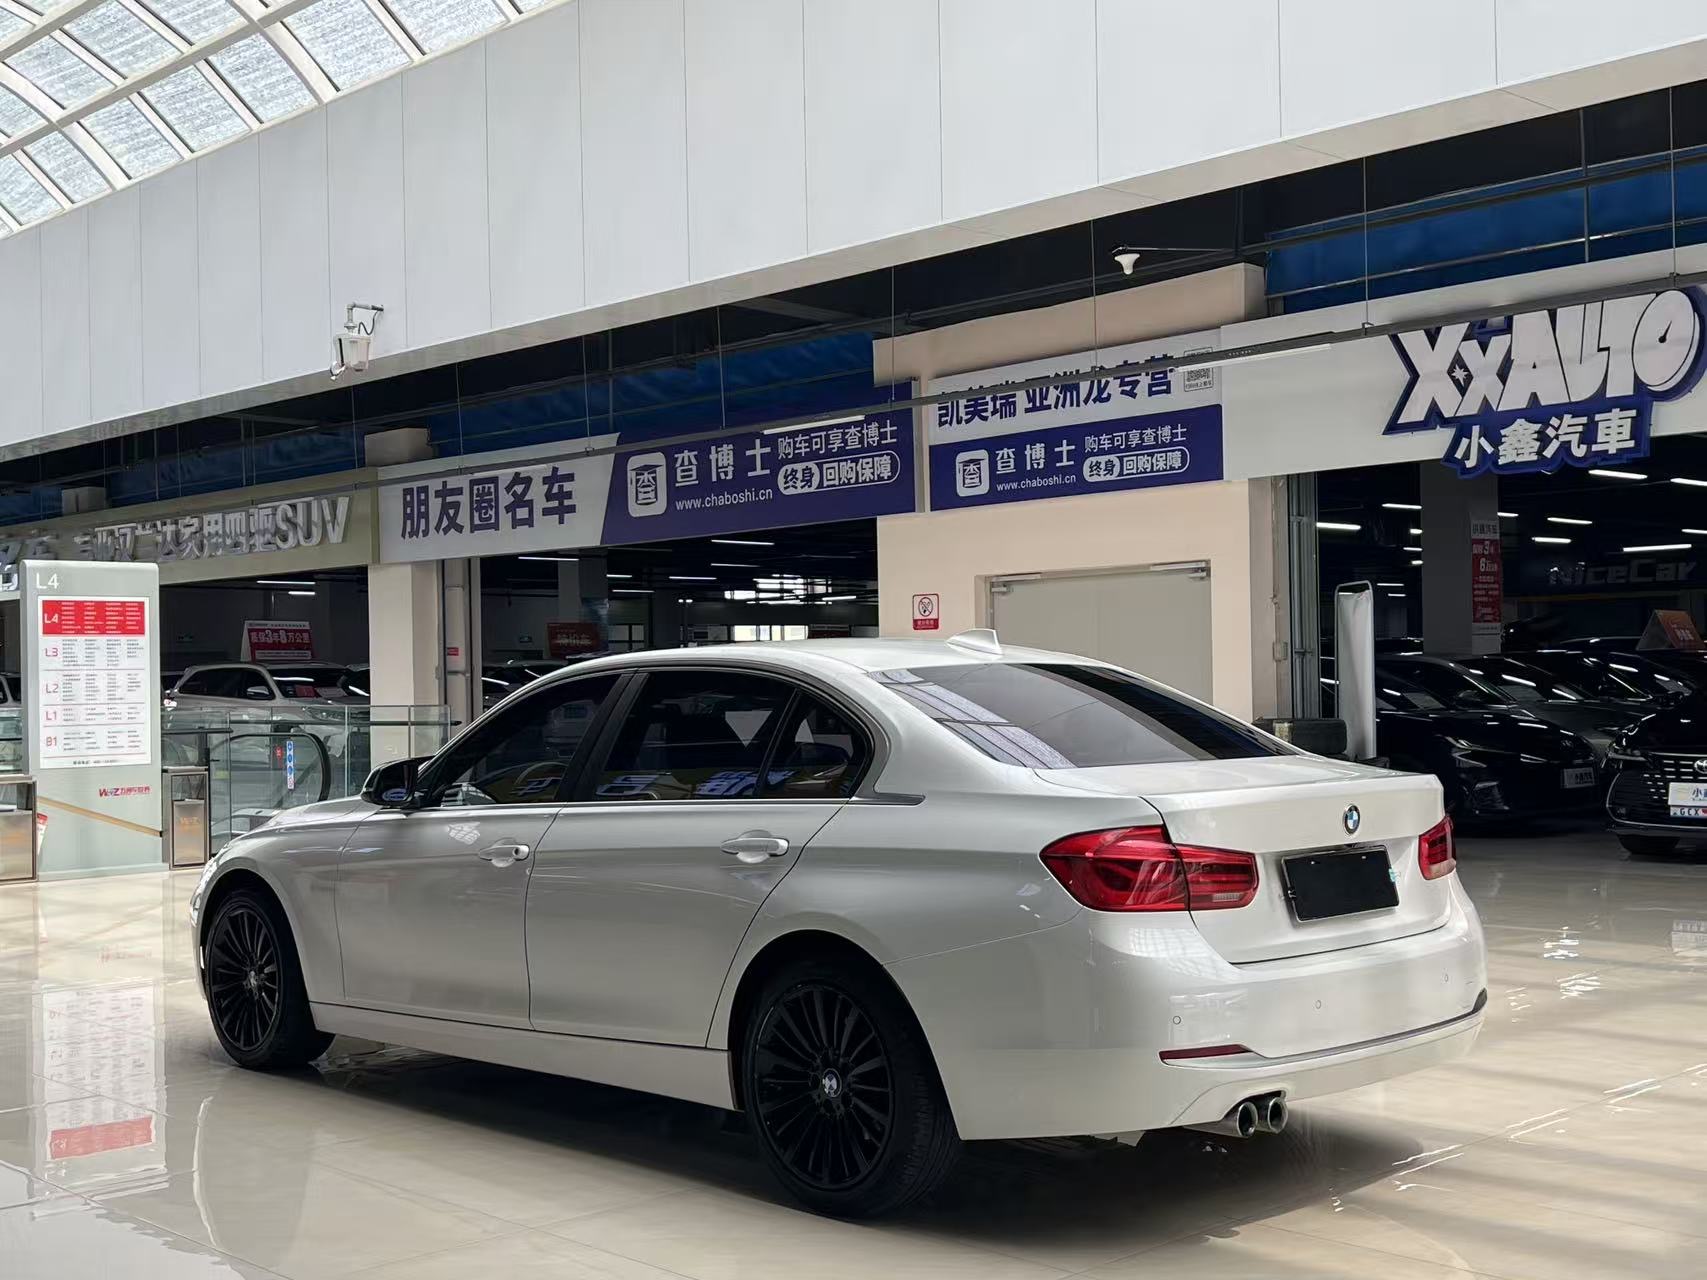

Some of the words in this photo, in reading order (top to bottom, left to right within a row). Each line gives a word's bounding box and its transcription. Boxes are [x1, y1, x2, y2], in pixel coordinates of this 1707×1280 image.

[778, 420, 898, 460] 购车可享查博士
[1085, 424, 1187, 453] 购车可享查博士
[1454, 408, 1637, 468] 小鑫汽車
[675, 439, 772, 487] 查博士
[996, 439, 1076, 474] 查博士
[1088, 459, 1118, 478] 终身
[1123, 451, 1182, 474] 回购保障
[783, 466, 817, 491] 终身
[822, 456, 893, 485] 回购保障
[996, 473, 1077, 492] www.chaboshi.cn
[400, 467, 576, 540] 朋友圈名车
[676, 487, 773, 511] www.chaboshi.cn
[36, 573, 60, 590] L4
[44, 613, 59, 624] L4
[45, 647, 59, 657] L3
[45, 683, 59, 693] L2
[45, 711, 57, 721] L1
[46, 736, 58, 746] B1
